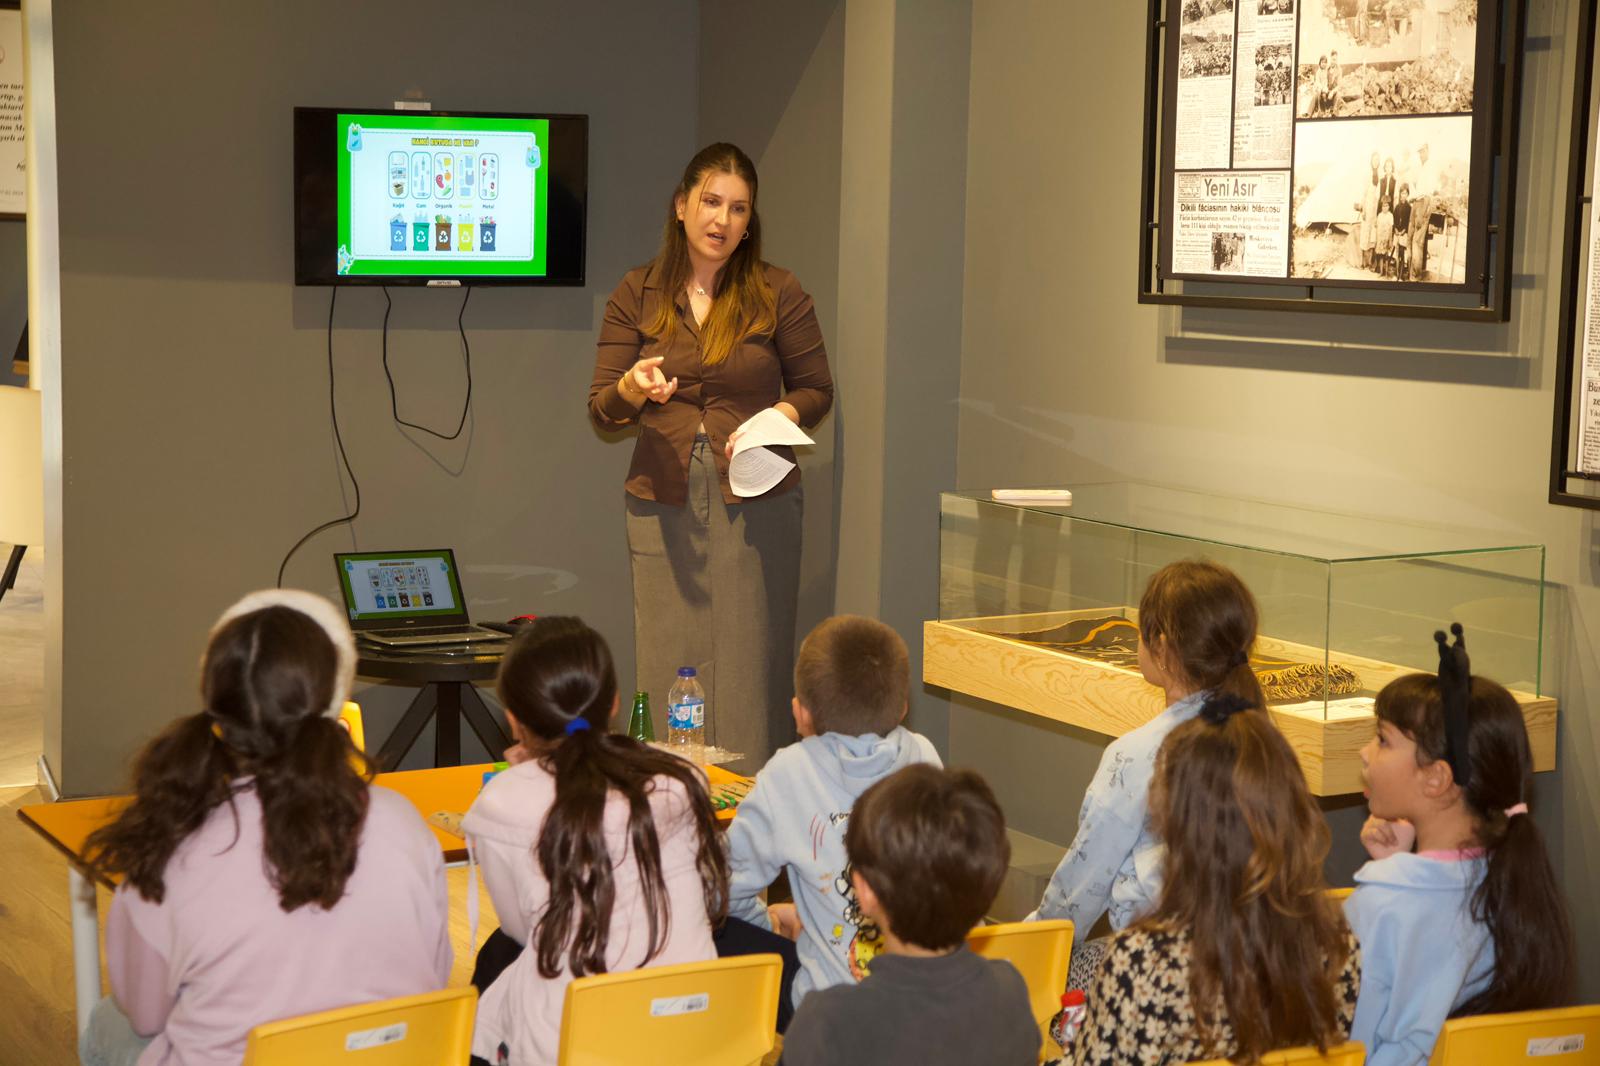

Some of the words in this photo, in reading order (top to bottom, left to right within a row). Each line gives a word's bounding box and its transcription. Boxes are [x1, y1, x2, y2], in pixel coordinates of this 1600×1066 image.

[1204, 178, 1230, 197] Yeni
[1233, 178, 1258, 197] Asır
[435, 202, 453, 210] Organik
[1180, 203, 1196, 212] Dikili
[1230, 204, 1249, 212] hakiki
